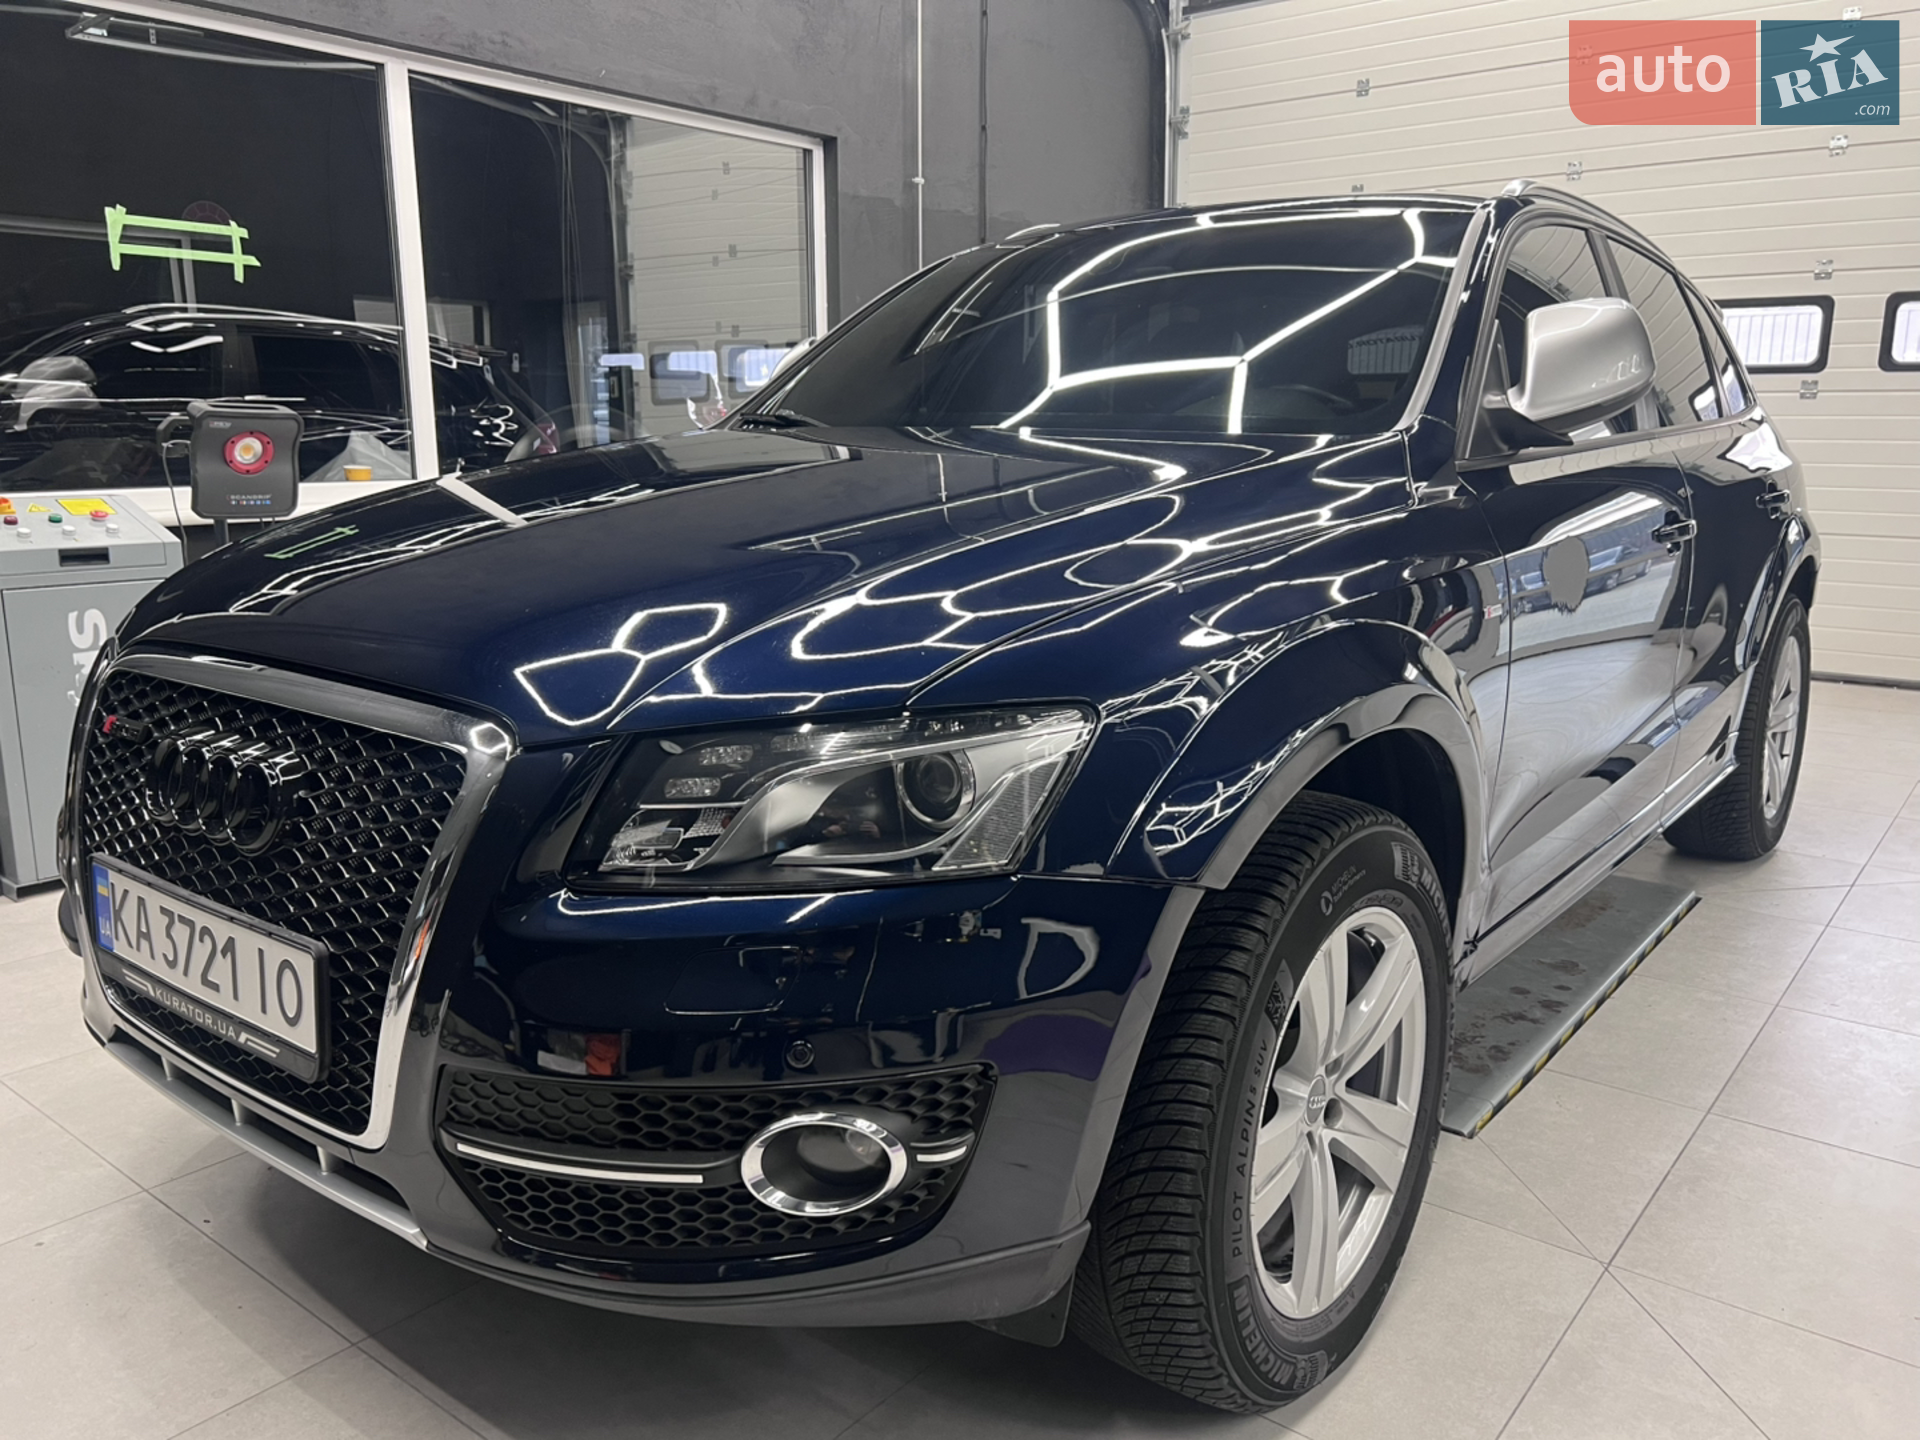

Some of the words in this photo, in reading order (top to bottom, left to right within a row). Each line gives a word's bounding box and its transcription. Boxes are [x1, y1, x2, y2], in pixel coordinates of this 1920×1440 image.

[99, 916, 112, 938] UA
[111, 882, 155, 961] KA
[159, 905, 239, 1002] 3721
[257, 947, 303, 1028] IO
[154, 987, 237, 1040] KURATOR.UA
[1254, 1039, 1268, 1077] SUV
[1236, 1099, 1256, 1178] ALPIN
[1232, 1191, 1243, 1258] PILOT
[1233, 1285, 1296, 1385] MICHELIN
